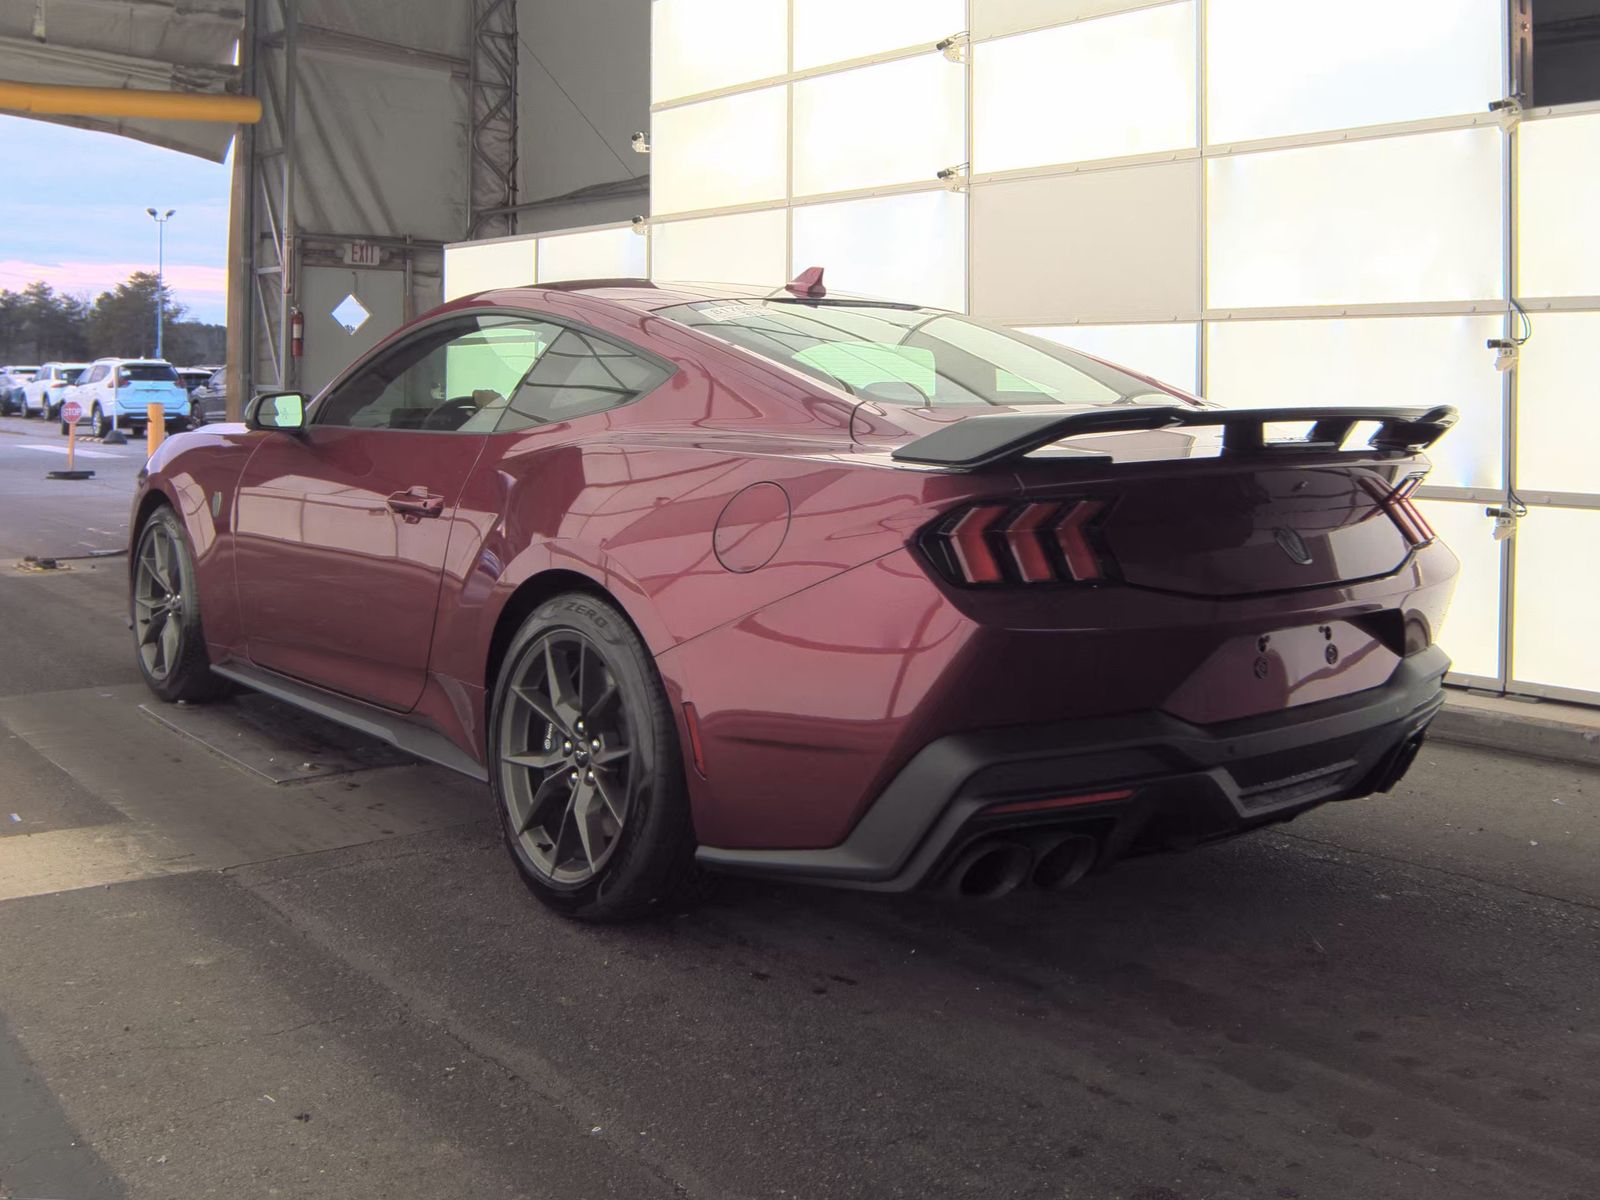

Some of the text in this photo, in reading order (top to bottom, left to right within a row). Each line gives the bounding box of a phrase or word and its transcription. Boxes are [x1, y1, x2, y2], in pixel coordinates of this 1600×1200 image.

[352, 243, 375, 263] EXIT
[63, 408, 81, 417] STOP
[563, 602, 608, 628] ZERO
